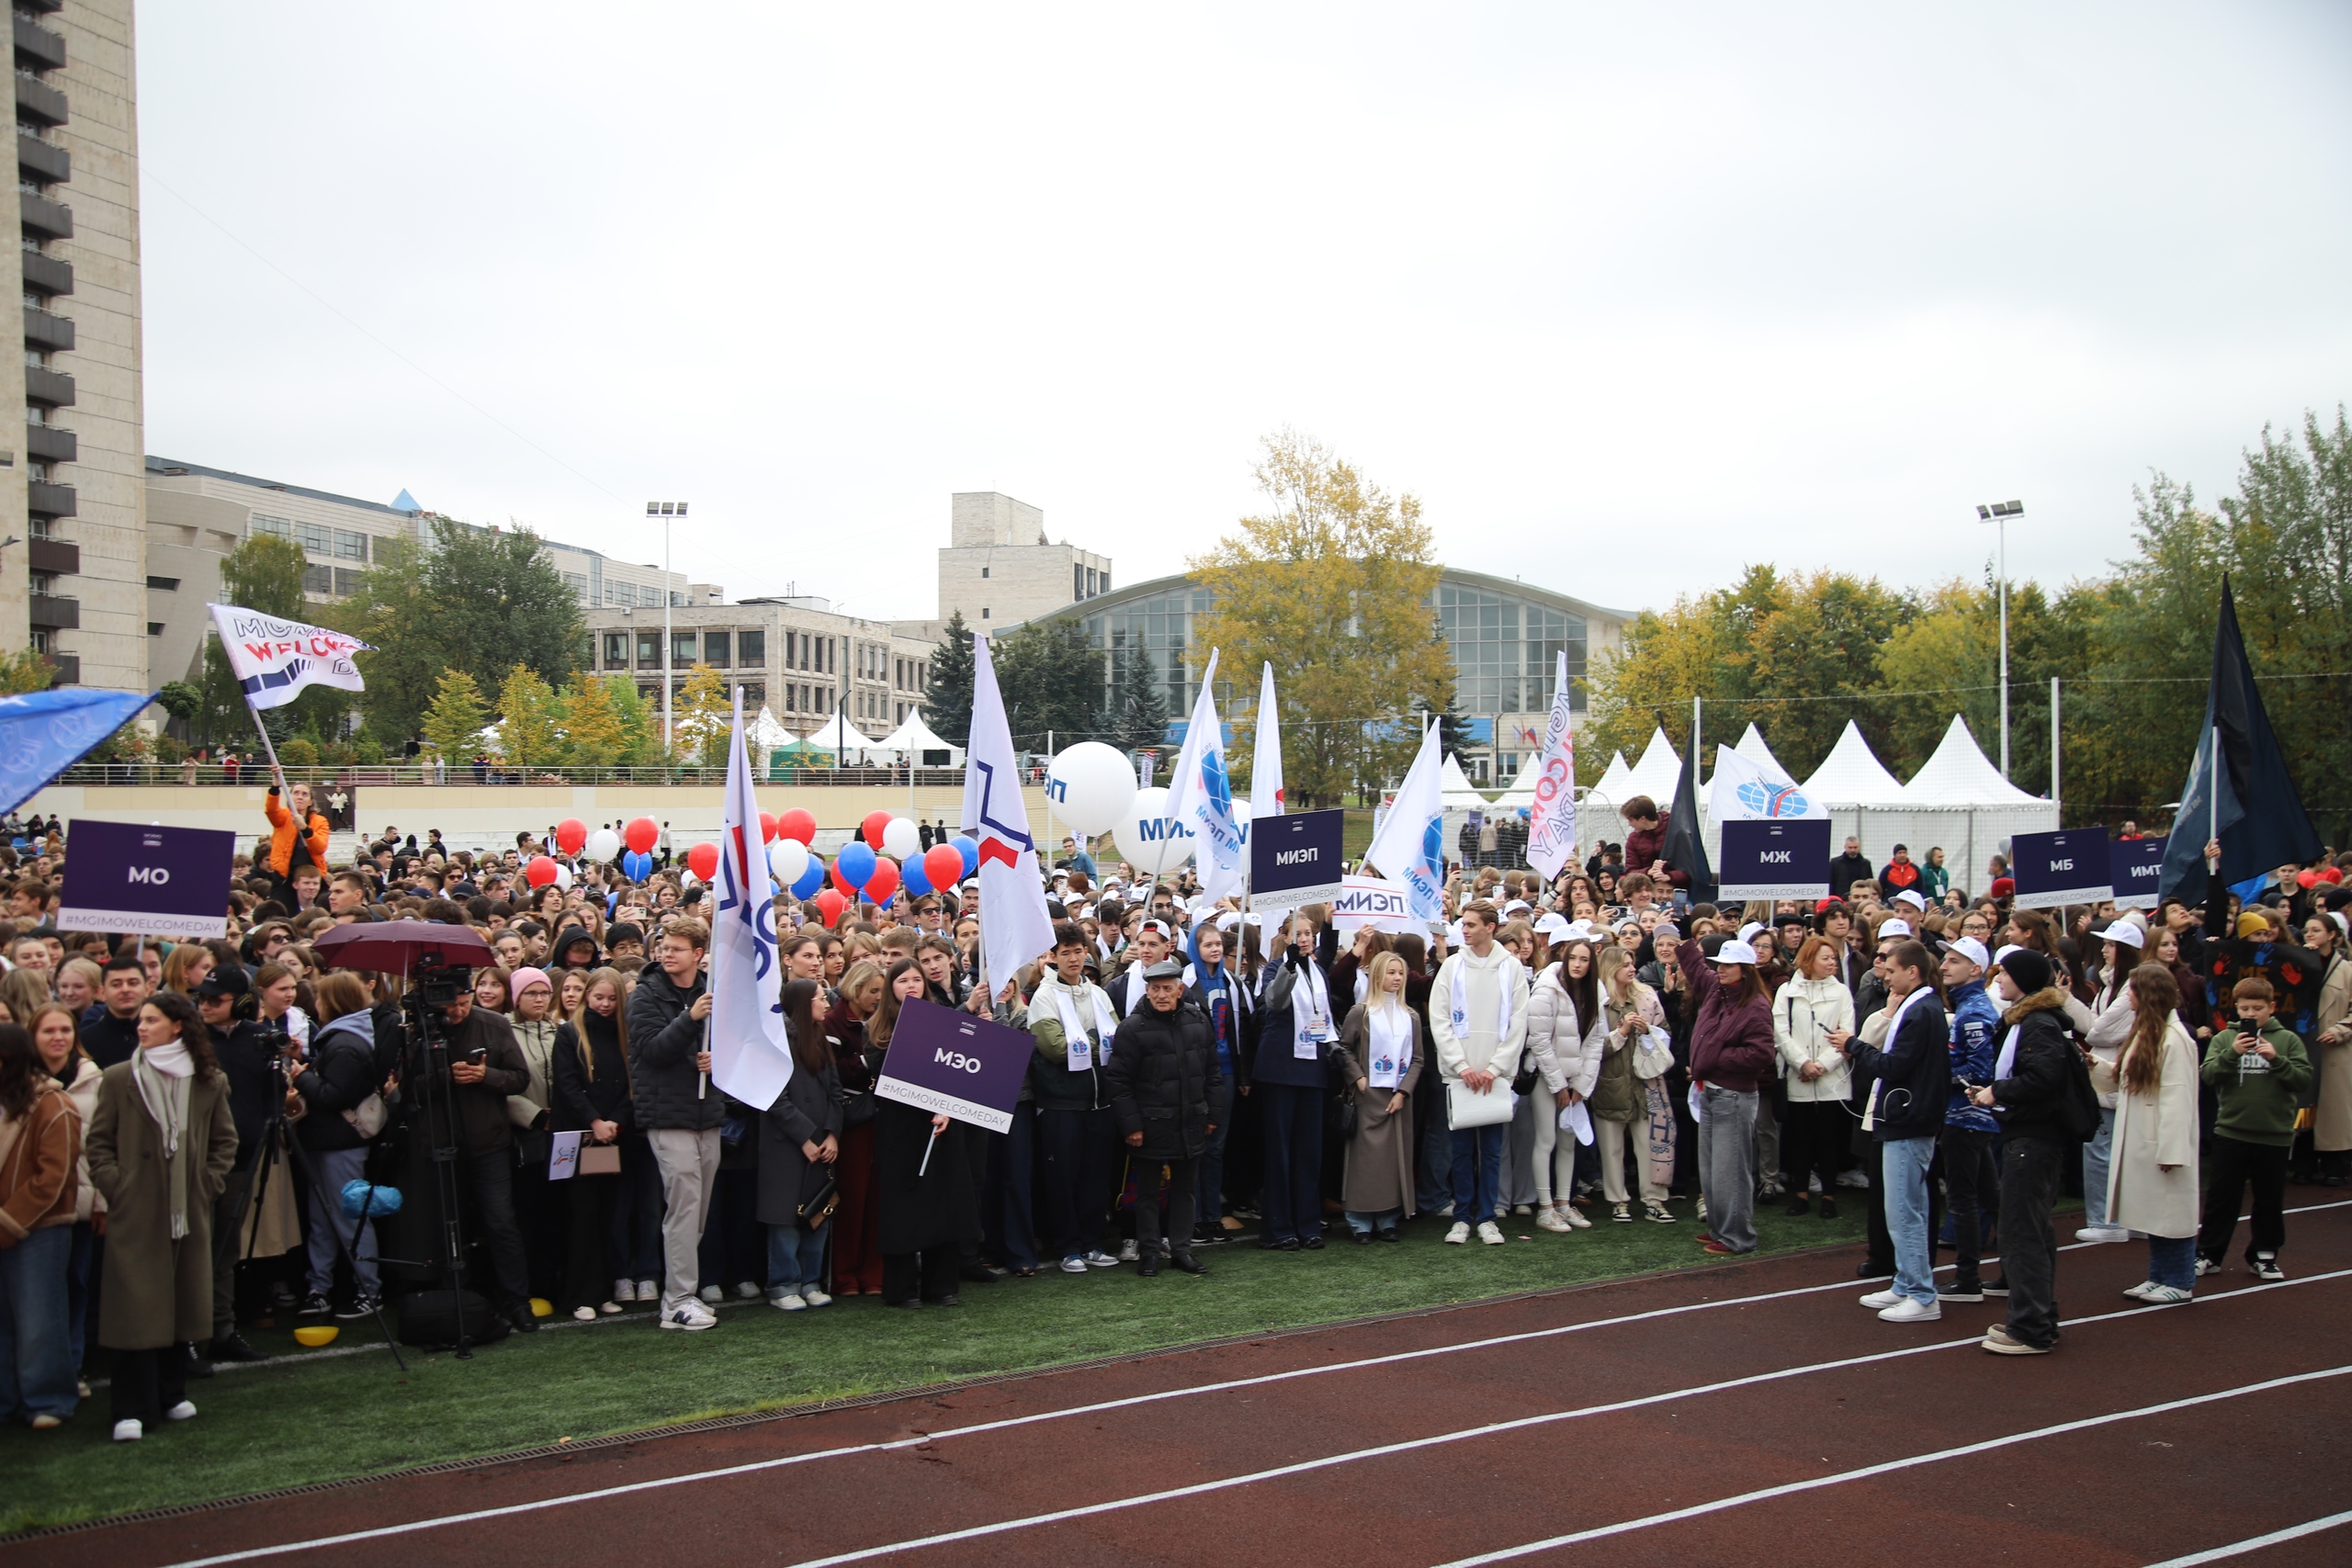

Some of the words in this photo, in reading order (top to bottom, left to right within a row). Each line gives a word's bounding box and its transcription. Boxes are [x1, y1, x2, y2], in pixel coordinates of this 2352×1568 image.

[1276, 847, 1318, 866] МИЭП
[1759, 851, 1792, 863] МЖ
[2050, 859, 2074, 872] МБ
[129, 866, 170, 886] МО
[1402, 866, 1435, 900] МИЭП
[1254, 888, 1340, 907] #MGIMOWELCOMEDAY
[1724, 888, 1825, 897] #MGIMOWELCOMEDAY
[2019, 891, 2109, 905] #MGIMOWELCOMEDAY
[1336, 892, 1404, 913] МИЭП
[65, 915, 221, 933] #MGIMOWELCOMEDAY
[933, 1047, 982, 1074] МЭО
[882, 1083, 1007, 1127] #MGIMOWELCOMEDAY
